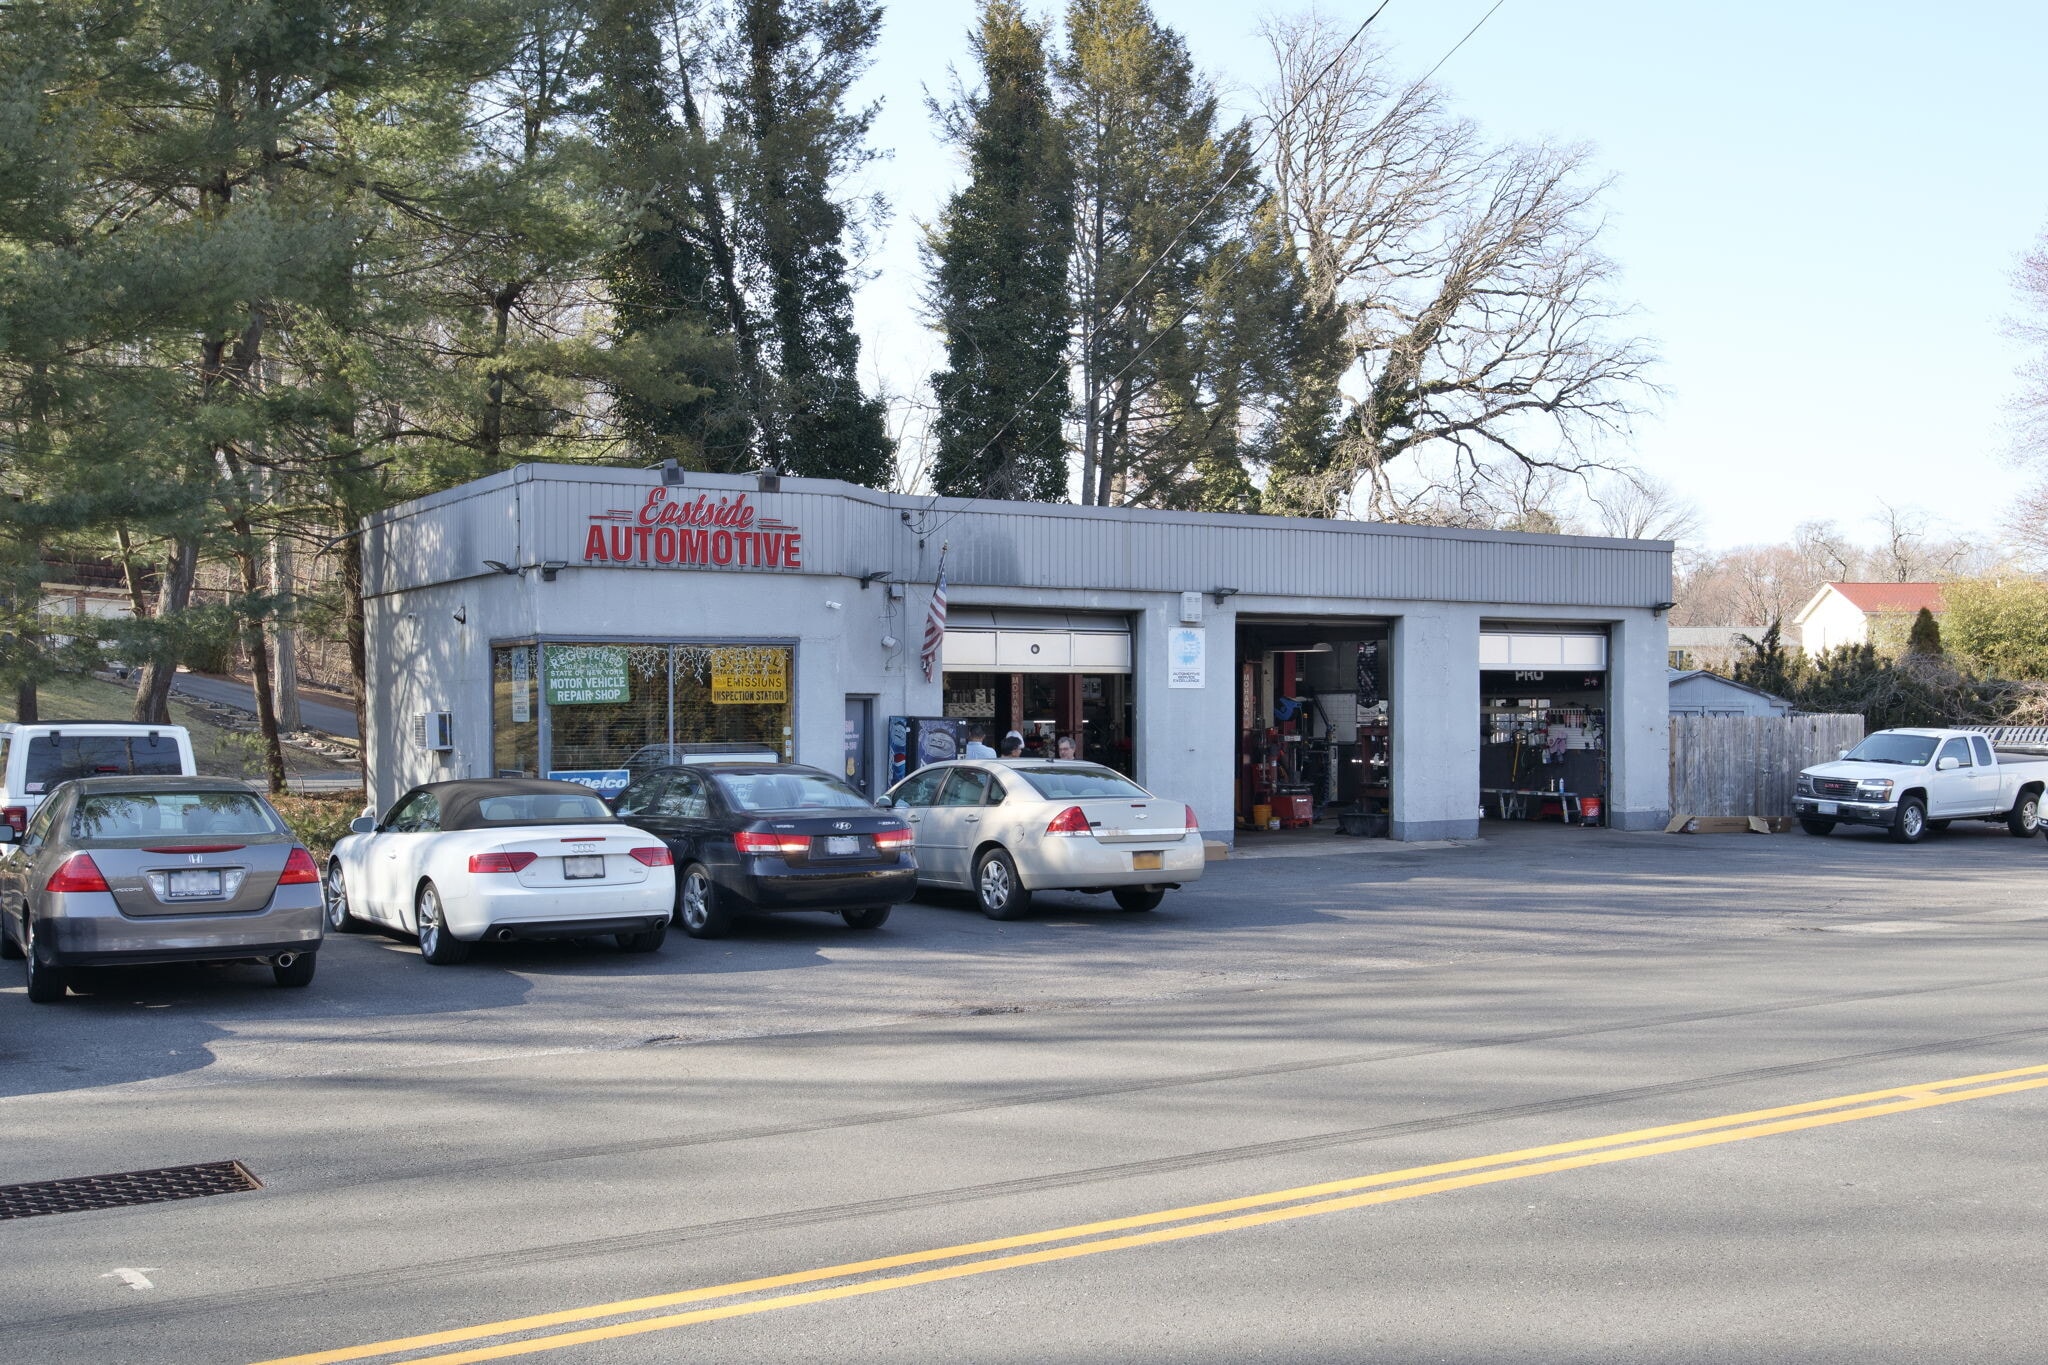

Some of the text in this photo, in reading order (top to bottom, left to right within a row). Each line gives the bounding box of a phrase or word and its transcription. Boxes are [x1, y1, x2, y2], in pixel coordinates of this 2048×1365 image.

[638, 486, 755, 529] Eastside
[583, 524, 802, 567] AUTOMOTIVE
[550, 676, 626, 689] MOTOR VEHICLE
[726, 677, 782, 688] EMISSIONS
[557, 689, 621, 702] REPAIR SHOP
[713, 690, 784, 701] INSPECTION STATION
[561, 777, 627, 789] Delco
